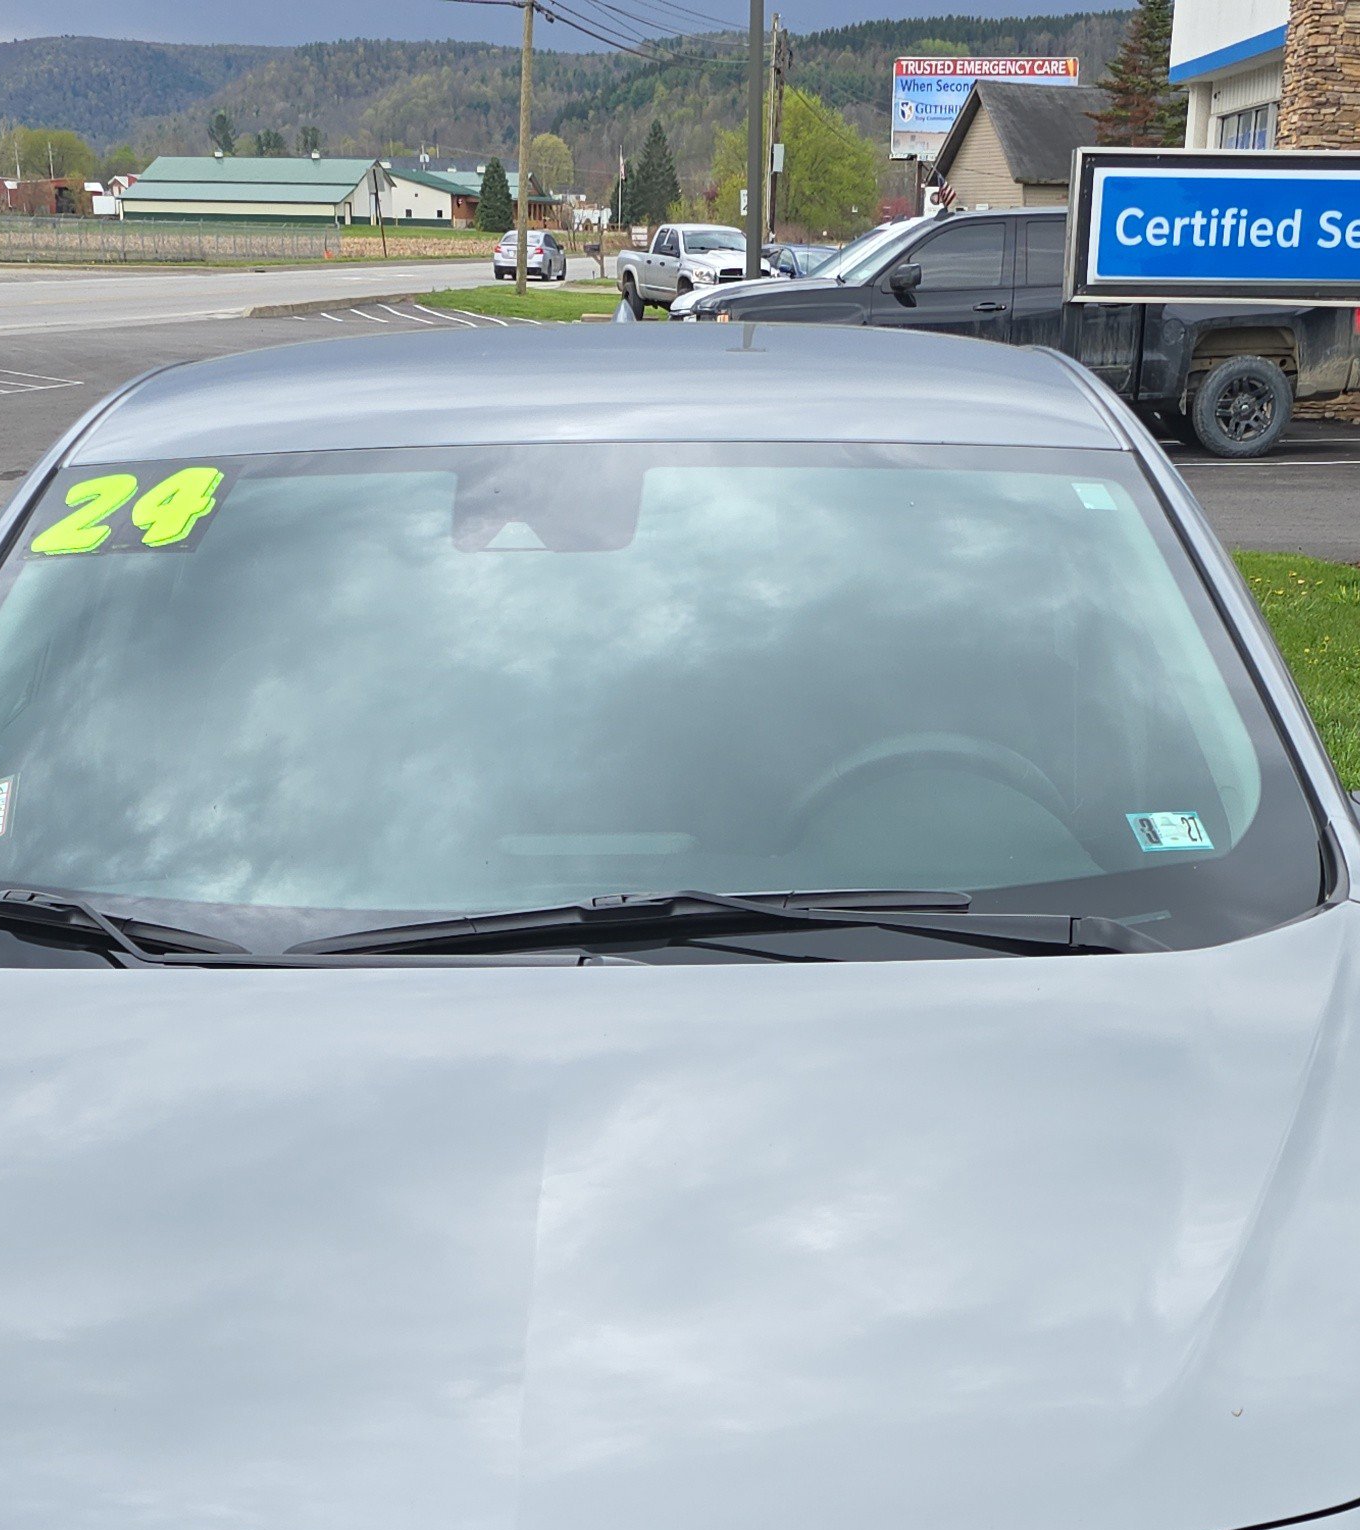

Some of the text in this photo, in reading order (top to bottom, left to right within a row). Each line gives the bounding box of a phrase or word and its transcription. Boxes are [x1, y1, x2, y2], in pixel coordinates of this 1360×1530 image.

[900, 60, 1067, 74] TRUSTED EMERGENCY CARE
[900, 79, 933, 92] When
[1115, 207, 1302, 249] Certified
[31, 467, 224, 555] 24
[1138, 816, 1203, 844] 3 27
